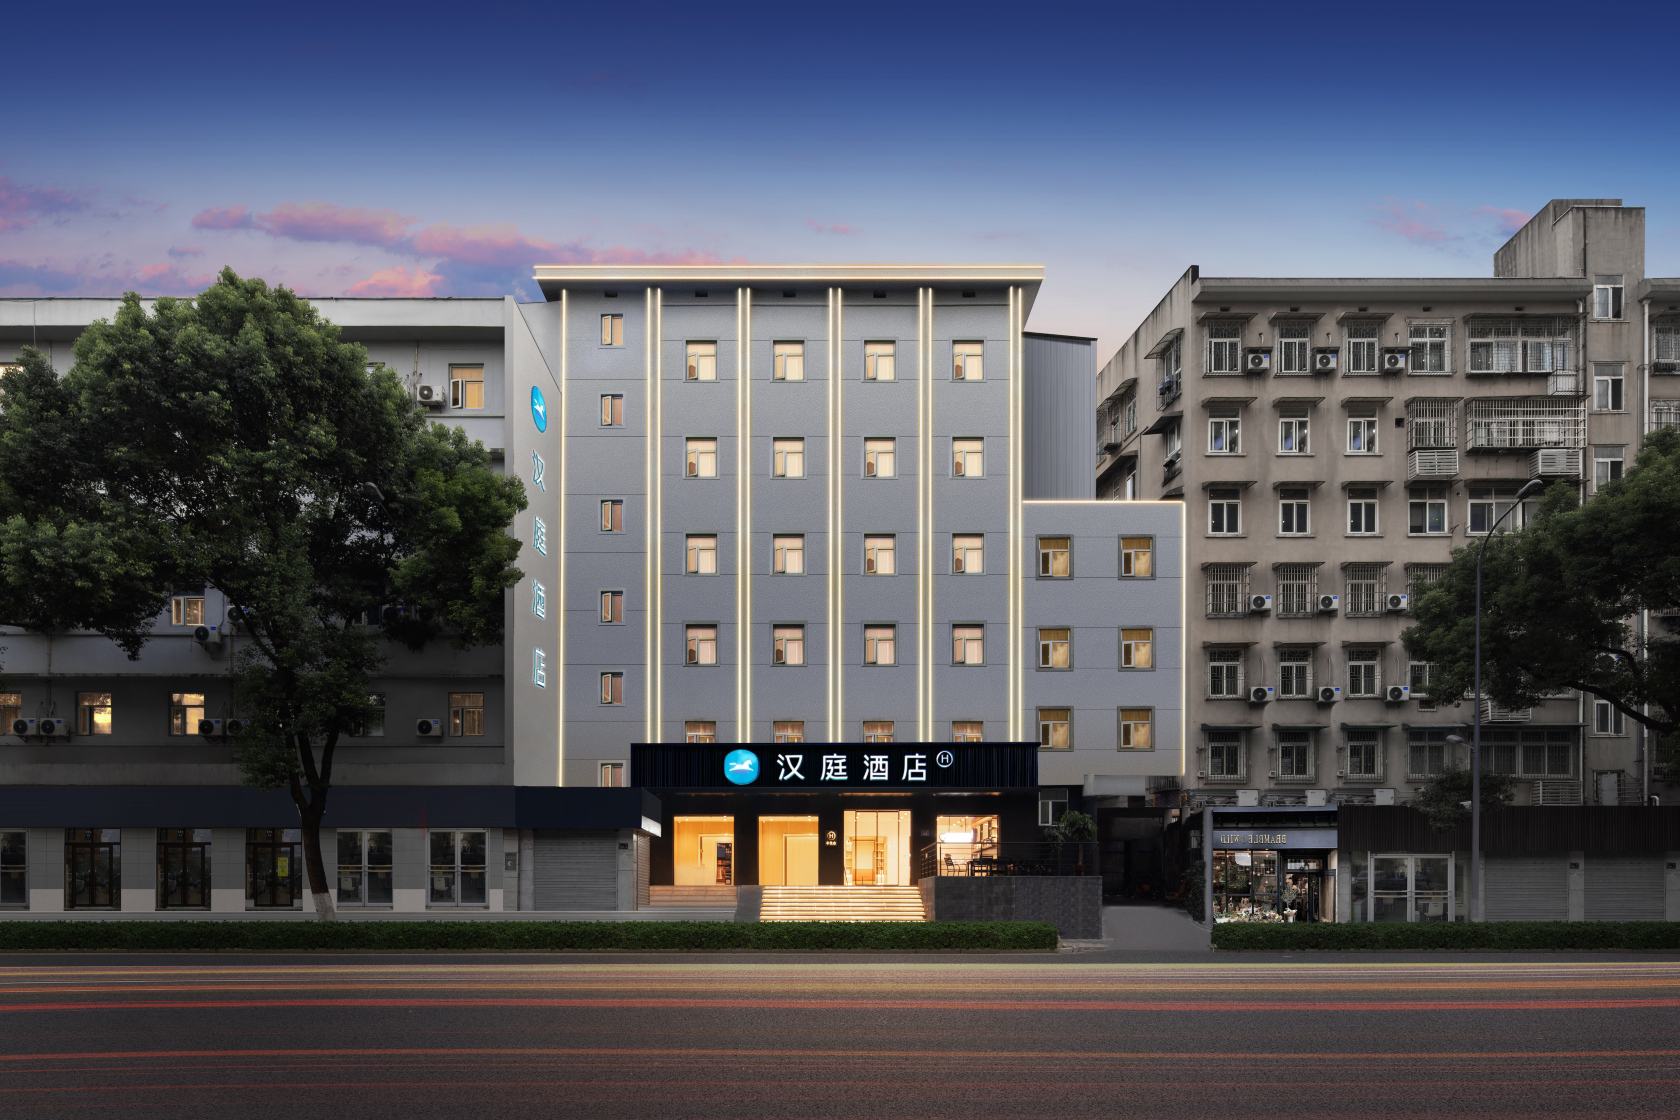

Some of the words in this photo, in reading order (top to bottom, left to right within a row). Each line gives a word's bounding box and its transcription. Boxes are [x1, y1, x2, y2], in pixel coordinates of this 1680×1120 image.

[532, 449, 546, 689] 汉庭酒店
[776, 753, 927, 781] 汉庭酒店
